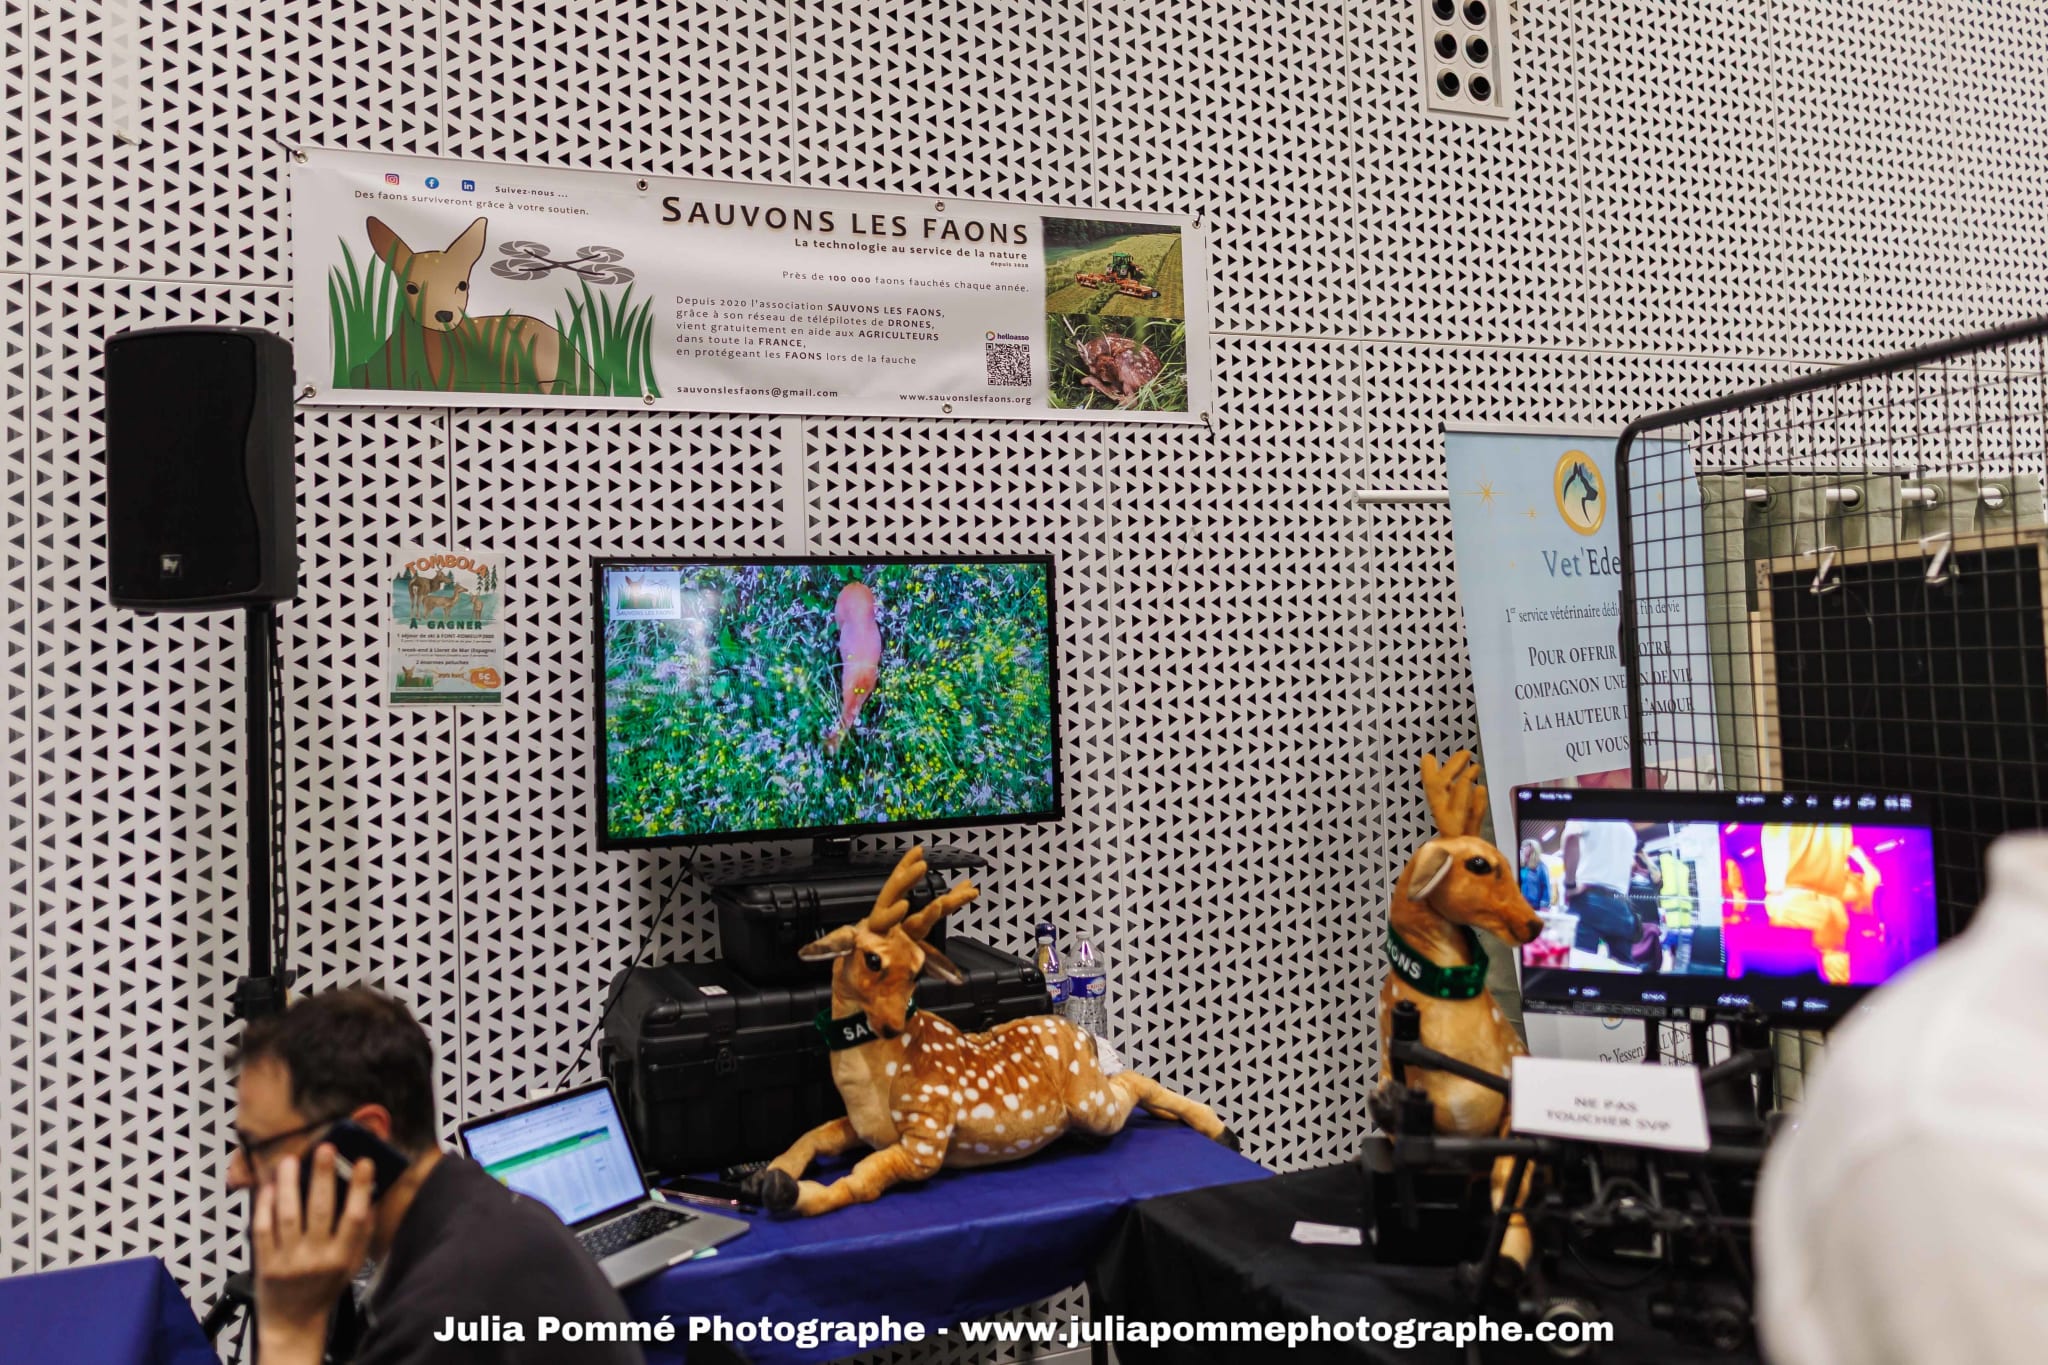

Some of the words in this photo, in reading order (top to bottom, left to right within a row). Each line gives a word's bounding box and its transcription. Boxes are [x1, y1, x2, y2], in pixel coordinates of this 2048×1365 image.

[355, 190, 374, 199] Des
[378, 191, 408, 201] faons
[411, 194, 473, 206] surviveront
[476, 199, 505, 210] grâce
[508, 201, 514, 210] à
[518, 203, 545, 212] votre
[548, 205, 589, 215] soutien.
[495, 186, 554, 197] Suivez-nous
[662, 196, 835, 233] SAUVONS
[852, 213, 907, 237] LES
[924, 217, 1028, 245] FAONS
[795, 238, 808, 247] La
[813, 240, 887, 254] technologie
[891, 245, 905, 253] au
[910, 246, 952, 256] service
[957, 247, 971, 257] de
[974, 248, 985, 258] la
[989, 251, 1028, 260] nature
[782, 270, 807, 280] Près
[811, 272, 824, 281] de
[829, 275, 847, 283] 100
[850, 275, 871, 284] 000
[874, 276, 905, 286] faons
[909, 277, 951, 288] fauchés
[954, 280, 991, 293] chaque
[995, 284, 1030, 293] année.
[676, 295, 716, 307] Depuis
[751, 299, 823, 311] l'association
[827, 303, 880, 314] SAUVONS
[883, 306, 902, 316] LES
[906, 308, 945, 319] FAONS,
[676, 308, 709, 320] grâce
[713, 310, 719, 319] à
[723, 312, 744, 320] son
[748, 312, 785, 322] réseau
[790, 314, 803, 323] de
[807, 315, 867, 326] télépilotes
[871, 318, 884, 327] de
[888, 319, 935, 330] DRONES,
[676, 322, 707, 331] vient
[710, 323, 787, 335] gratuitement
[808, 327, 831, 337] aide
[858, 330, 940, 341] AGRICULTEURS
[676, 334, 704, 344] dans
[708, 335, 740, 345] toute
[744, 336, 754, 345] la
[758, 337, 806, 349] FRANCE,
[997, 332, 1030, 341] helloasso
[676, 348, 690, 356] en
[694, 348, 761, 360] protégeant
[765, 350, 781, 359] les
[785, 351, 822, 361] FAONS
[826, 353, 847, 362] lors
[850, 353, 864, 362] de
[867, 354, 877, 363] la
[881, 354, 917, 365] fauche
[676, 386, 838, 398] sauvonslesfaons@gmail.com
[899, 393, 1032, 406] www.sauvonslesfaons.org
[405, 554, 489, 578] TOMBOLA
[1542, 546, 1622, 577] Vet'Ede
[1518, 607, 1548, 623] service
[1550, 603, 1601, 620] vétérinaire
[1655, 600, 1667, 614] de
[1667, 600, 1681, 613] vie
[427, 620, 483, 630] GAGNER
[1569, 644, 1617, 663] OFFRIR
[1639, 640, 1672, 657] OTRE
[1514, 676, 1600, 701] COMPAGNON
[1604, 673, 1627, 691] UNE
[1522, 711, 1533, 732] À
[1535, 714, 1553, 730] LA
[1555, 706, 1622, 728] HAUTEUR
[1565, 740, 1592, 763] QUI
[1595, 735, 1630, 755] VOUS
[1613, 1041, 1646, 1063] Yesseni
[1574, 1097, 1597, 1109] NE
[1603, 1099, 1639, 1113] PAS
[1546, 1109, 1632, 1128] TOUCHER
[1636, 1117, 1671, 1131] SVP
